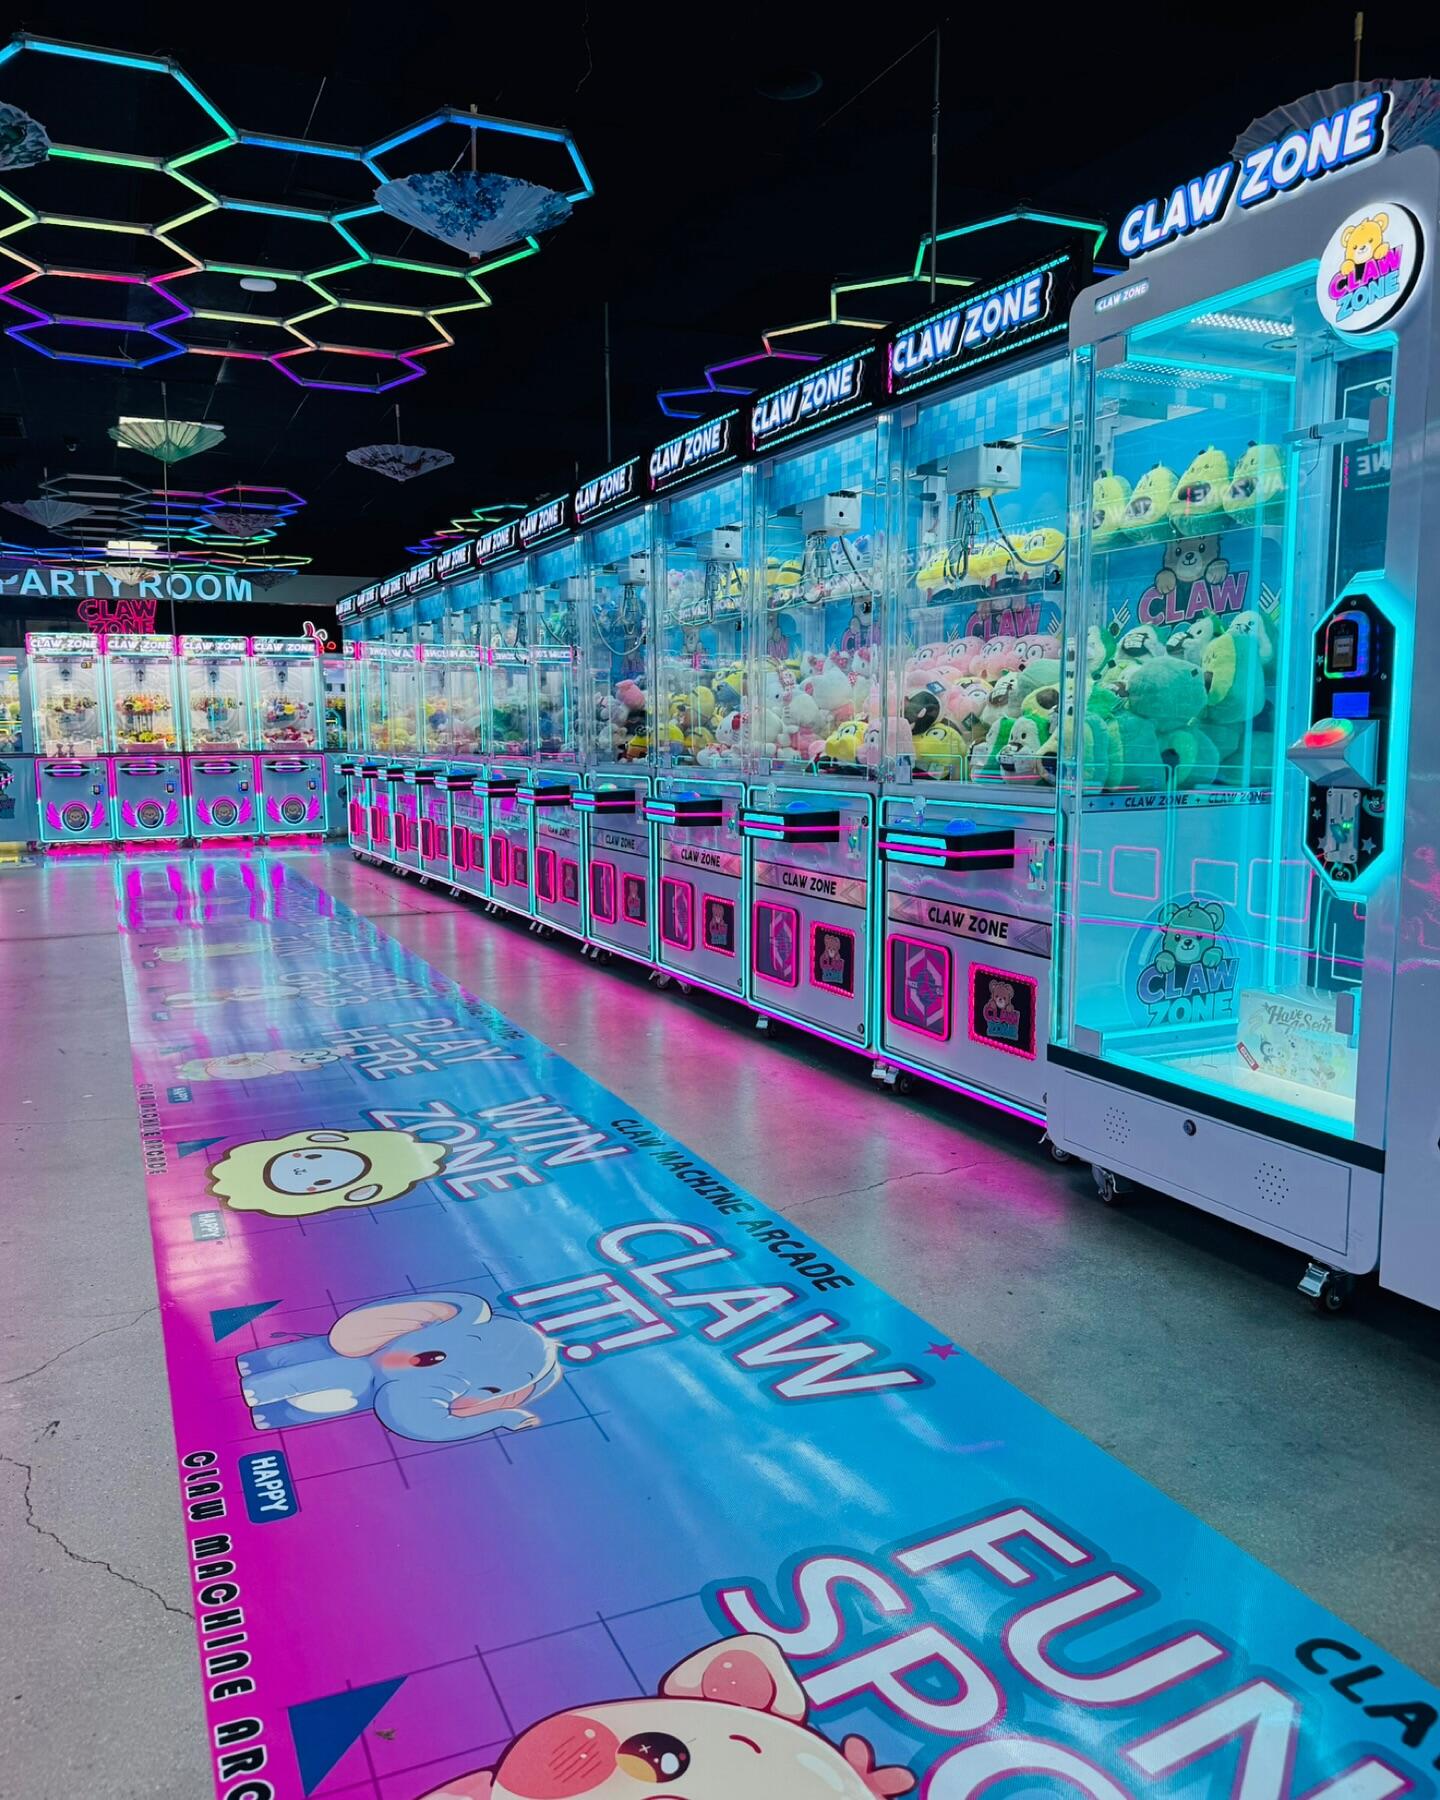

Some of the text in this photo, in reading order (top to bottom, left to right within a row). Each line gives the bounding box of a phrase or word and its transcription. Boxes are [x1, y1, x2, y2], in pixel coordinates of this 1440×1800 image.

[1118, 96, 1381, 256] CLAW ZONE
[1096, 282, 1149, 312] CLAW ZONE
[1328, 244, 1403, 322] CLAW ZONE
[892, 276, 1041, 373] CLAW ZONE
[752, 365, 854, 433] CLAW ZONE
[650, 423, 720, 477] CLAW ZONE
[574, 466, 626, 514] CLAW ZONE
[519, 503, 559, 538] CLAW ZONE
[476, 527, 510, 557] CLAW ZONE
[139, 573, 252, 601] ROOM
[1138, 571, 1249, 626] CLAW
[77, 599, 157, 634] CLAW ZONE
[966, 602, 1041, 641] CLAW
[30, 639, 97, 649] CLAW ZONE
[107, 641, 173, 650] CLAW ZONE
[182, 642, 245, 651] CLAW ZONE
[254, 643, 315, 652] CLAW ZONE
[1124, 794, 1189, 808] CLAW ZONE
[1207, 790, 1267, 804] CLAW ZONE
[605, 834, 636, 850] CLAW ZONE
[680, 849, 721, 868] CLAW ZONE
[782, 872, 837, 896] CLAW ZONE
[927, 906, 1009, 939] CLAW ZONE
[279, 971, 369, 1008] GRAB
[1137, 957, 1240, 1028] CLAW ZONE
[1268, 1004, 1304, 1025] Have
[320, 1017, 518, 1081] PLAY HERE
[143, 1138, 168, 1176] ARCADE
[367, 1094, 632, 1201] WIN ZONE
[610, 1118, 856, 1293] CLAW MACHINE ARCADE
[197, 1211, 222, 1240] HAPPY
[508, 1221, 925, 1401] CLAW IT!
[182, 1450, 227, 1522] CLAW
[250, 1455, 290, 1513] HAPPY
[191, 1533, 256, 1703] MACHINE
[895, 1507, 1414, 1800] FUN
[1295, 1637, 1440, 1772] CLA
